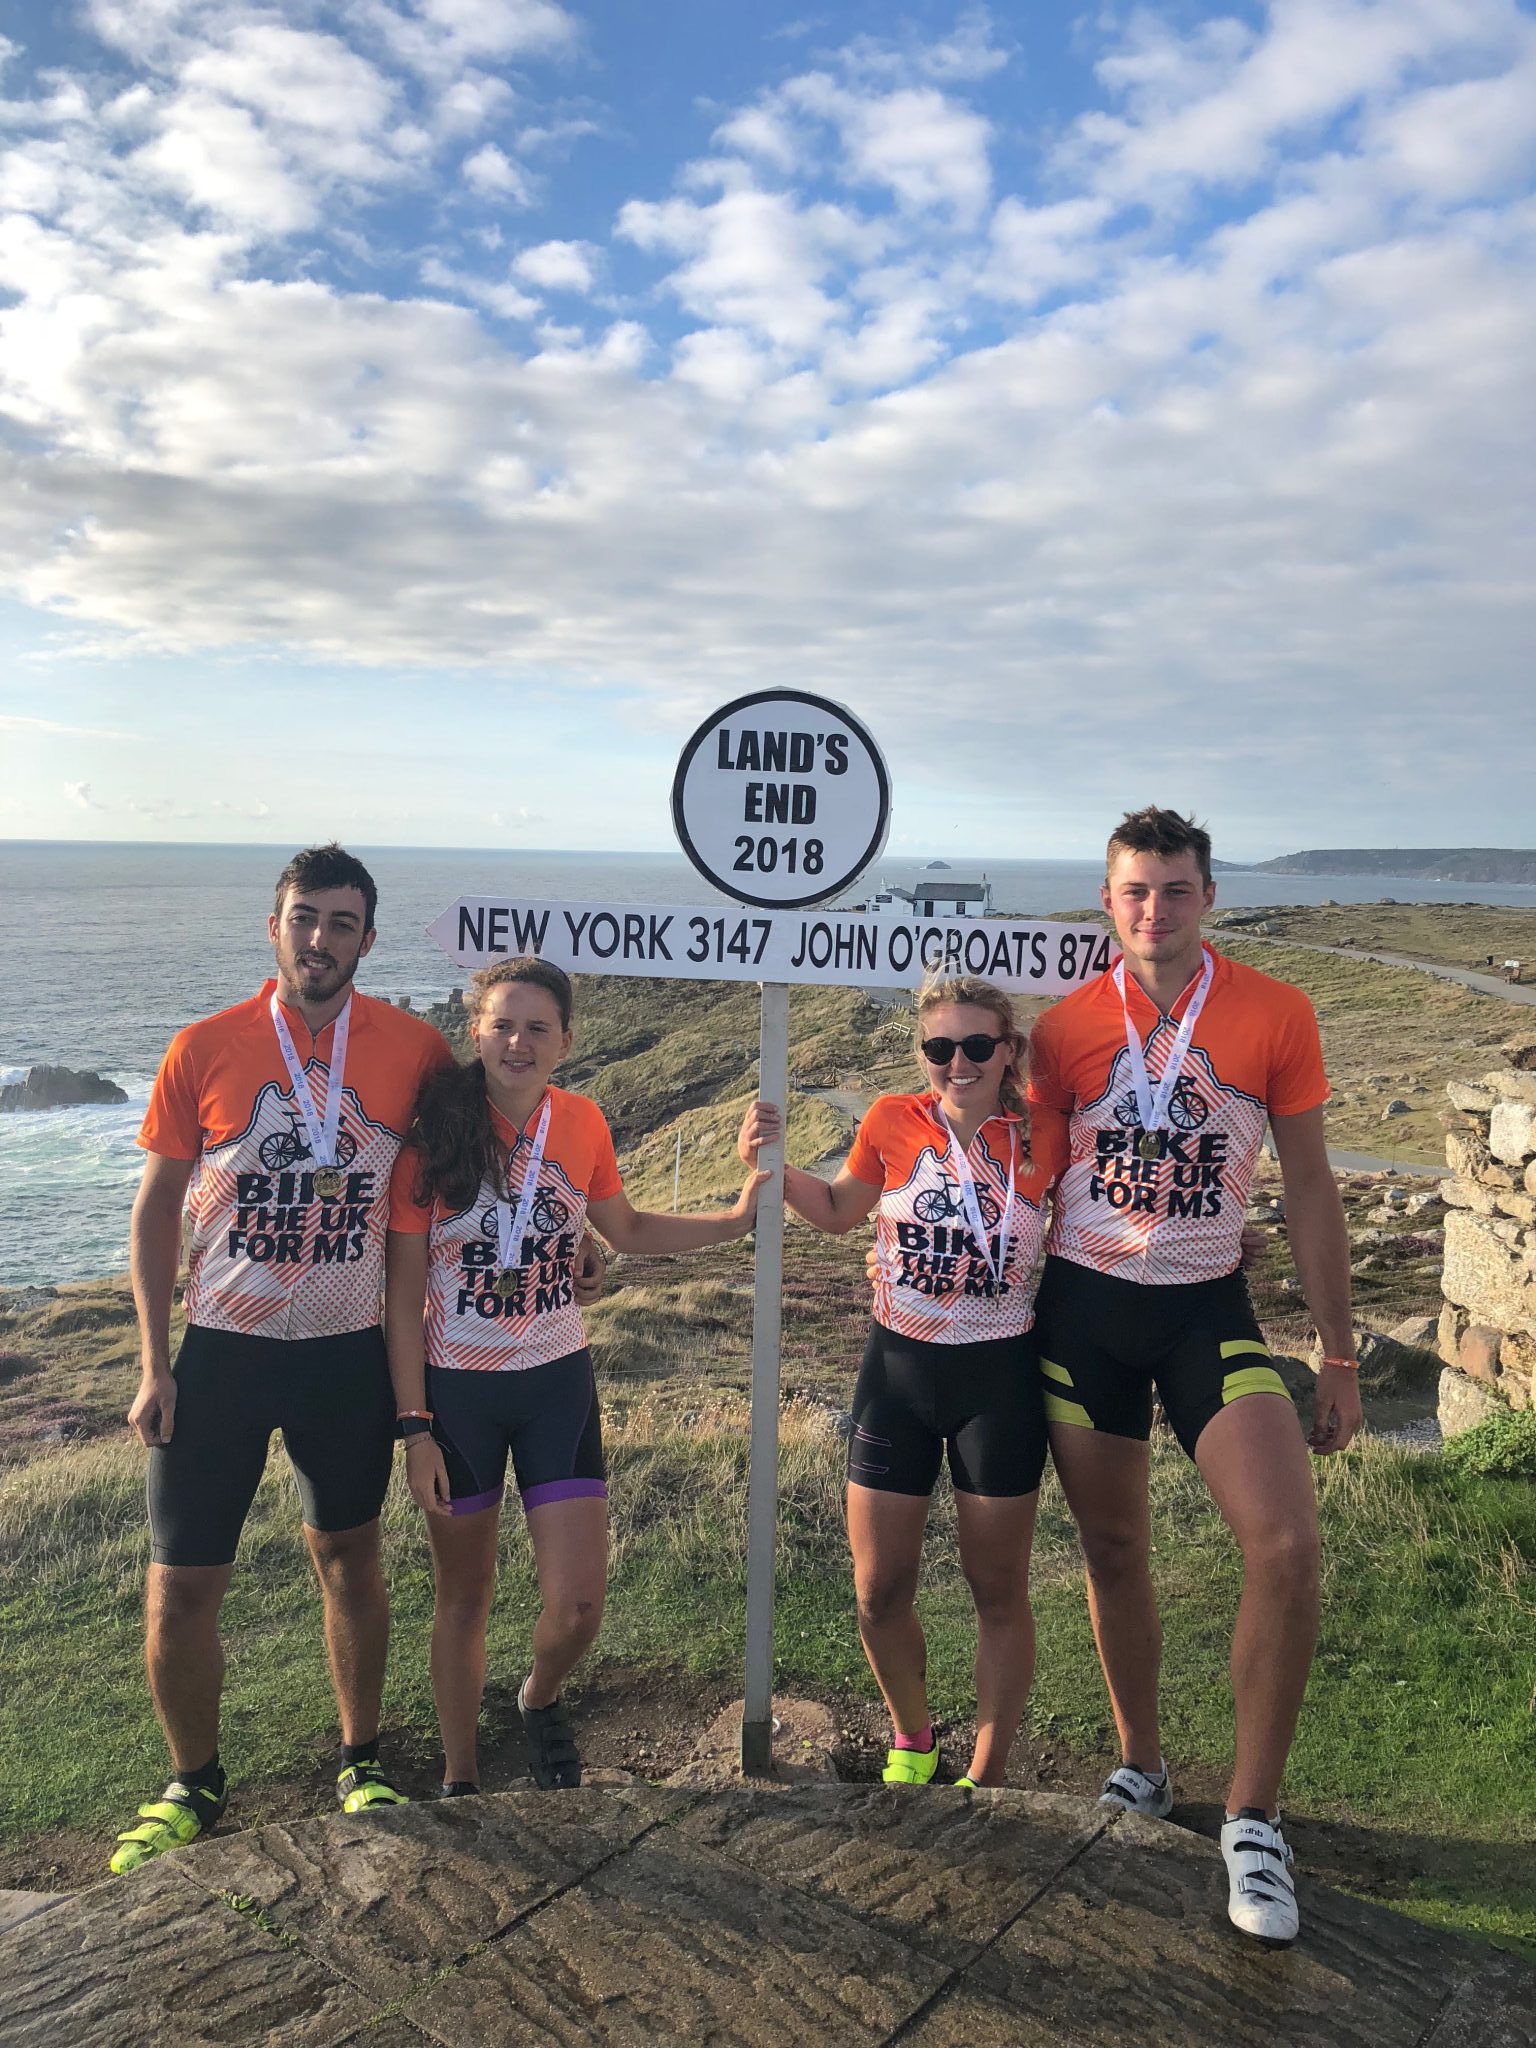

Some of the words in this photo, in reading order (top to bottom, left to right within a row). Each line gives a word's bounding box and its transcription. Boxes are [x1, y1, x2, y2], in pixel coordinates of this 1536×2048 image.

[718, 729, 848, 775] LAND'S
[744, 782, 817, 825] END
[732, 835, 824, 875] 2018
[458, 906, 550, 955] NEW
[563, 911, 675, 961] YORK
[686, 916, 773, 965] 3147
[791, 922, 878, 970] JOHN
[888, 925, 1047, 979] O'GROATS
[1058, 932, 1111, 980] 874
[1096, 1155, 1161, 1186] THE
[1173, 1165, 1225, 1189] UK
[1090, 1174, 1157, 1214] FOR
[1168, 1189, 1223, 1219] MS
[237, 1206, 307, 1231] THE
[321, 1206, 371, 1231] UK
[228, 1231, 304, 1263] FOR
[312, 1232, 365, 1264] MS
[462, 1231, 576, 1266] BKE
[898, 1249, 958, 1276] THE
[540, 1261, 572, 1284] UK
[457, 1288, 526, 1319] FOR
[536, 1280, 572, 1315] MS
[1245, 1827, 1264, 1838] dhb
